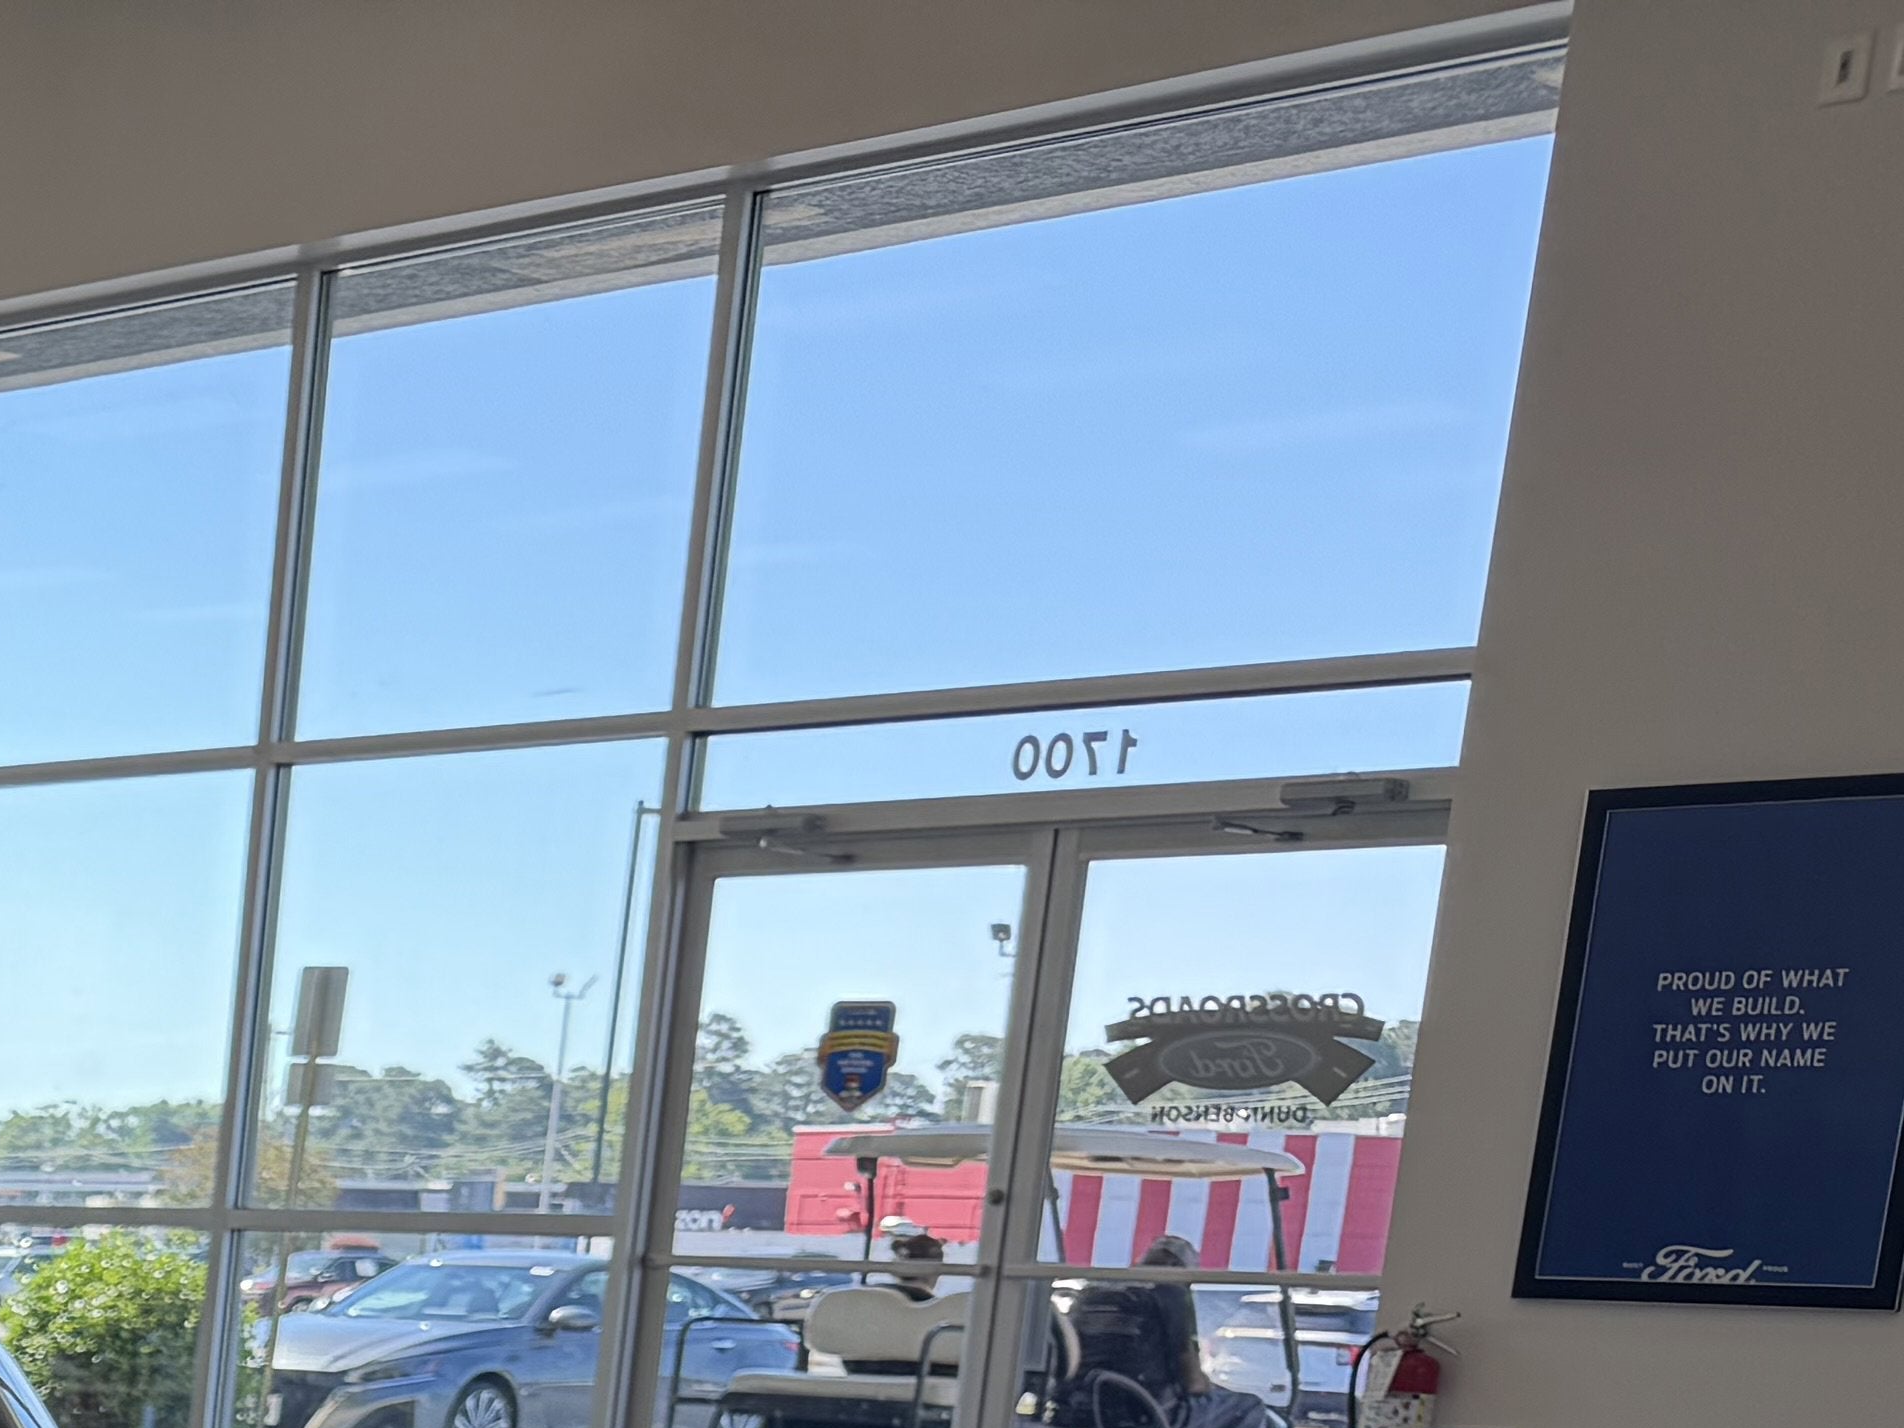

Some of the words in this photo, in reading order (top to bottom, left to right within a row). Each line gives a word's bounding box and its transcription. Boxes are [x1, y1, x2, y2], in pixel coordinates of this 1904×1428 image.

[1657, 971, 1736, 991] PROUD
[1742, 969, 1773, 989] OF
[1782, 968, 1850, 988] WHAT
[1691, 997, 1725, 1016] WE
[1732, 996, 1805, 1016] BUILD.
[1652, 1023, 1731, 1043] THAT'S
[1740, 1022, 1793, 1042] WHY
[1802, 1021, 1837, 1041] WE
[1652, 1049, 1699, 1069] PUT
[1705, 1049, 1753, 1068] OUR
[1760, 1048, 1827, 1067] NAME
[1702, 1075, 1734, 1094] ON
[1741, 1074, 1766, 1094] IT.
[1641, 1245, 1762, 1285] Ford
